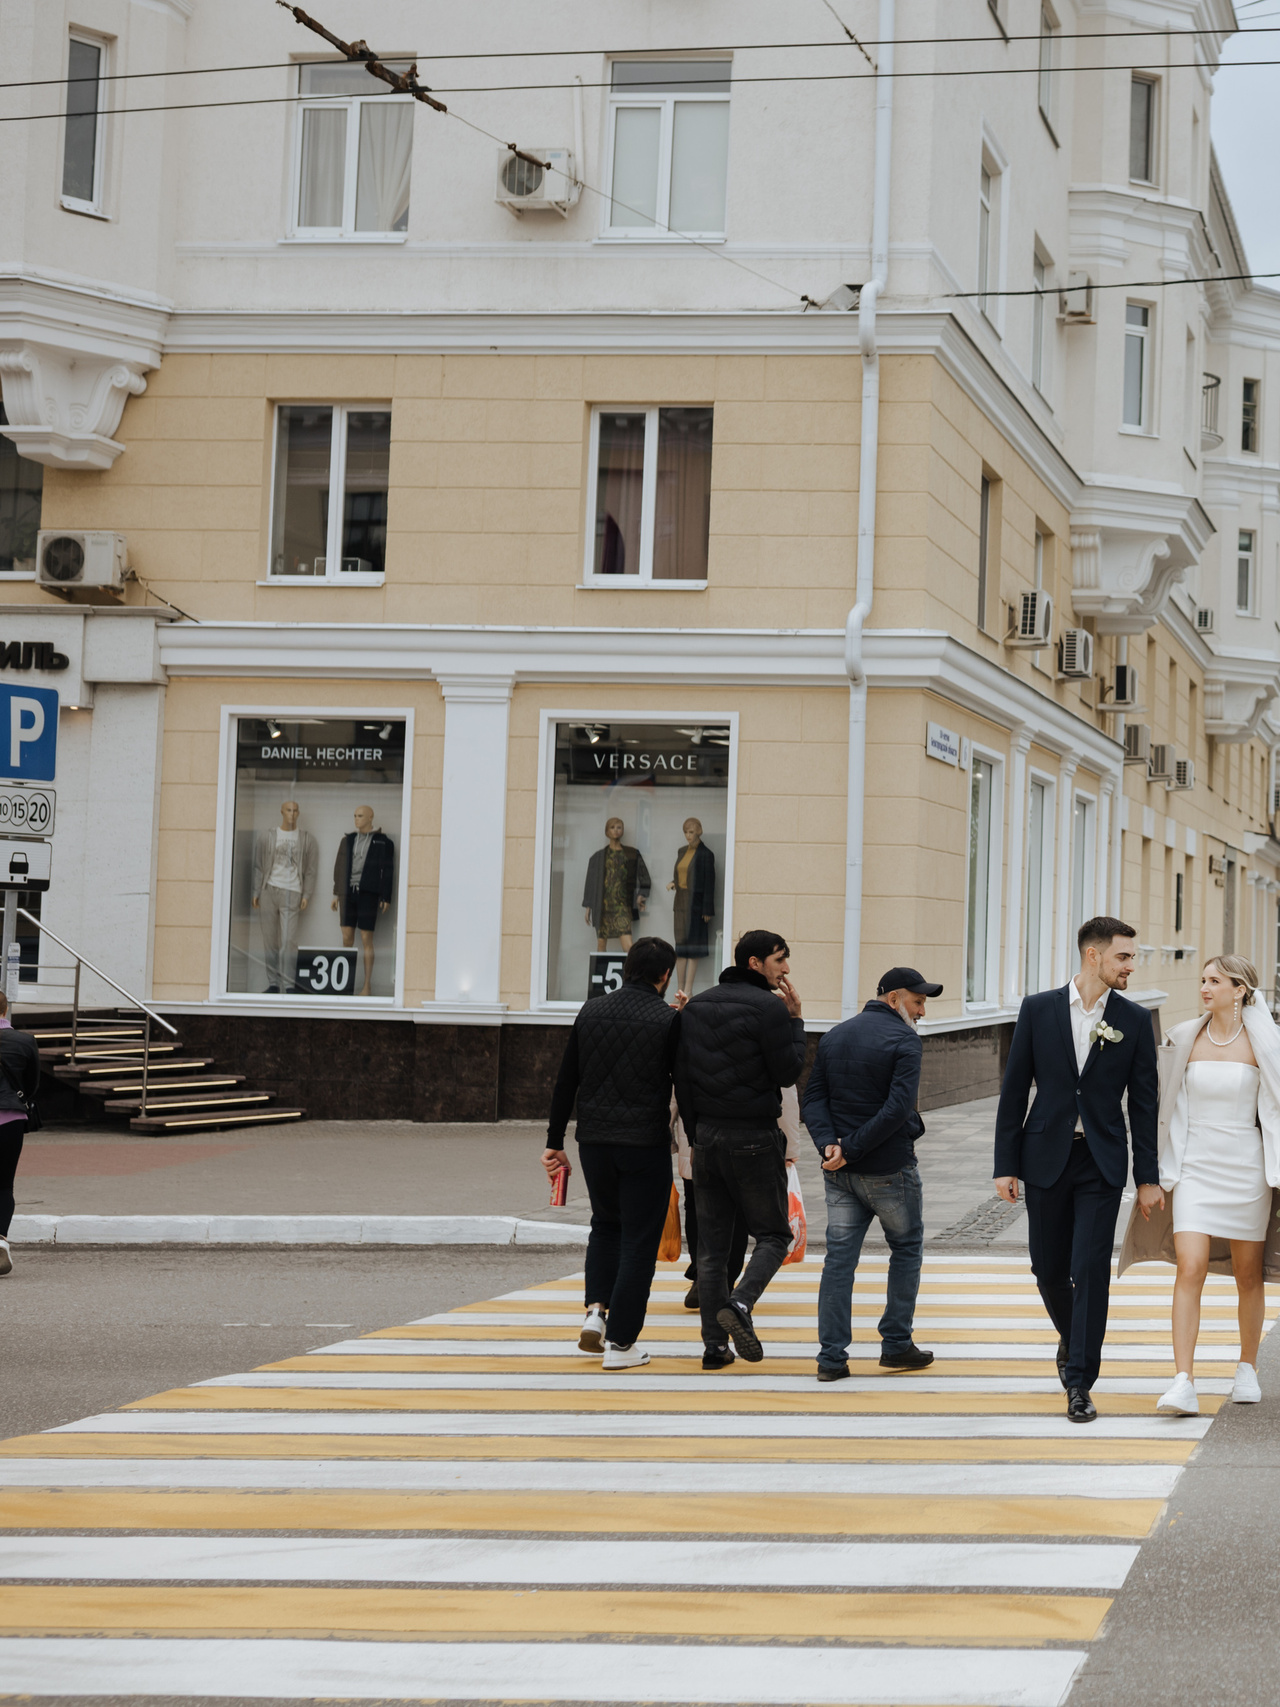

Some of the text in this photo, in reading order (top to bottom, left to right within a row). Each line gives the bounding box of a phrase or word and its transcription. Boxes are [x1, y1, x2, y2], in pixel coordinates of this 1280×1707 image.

[10, 695, 45, 767] P
[261, 746, 383, 761] DANIEL HECHTER
[593, 753, 698, 771] VERSACE
[13, 802, 25, 819] 15
[29, 801, 48, 823] 20
[299, 955, 350, 991] -30
[592, 961, 623, 994] -5
